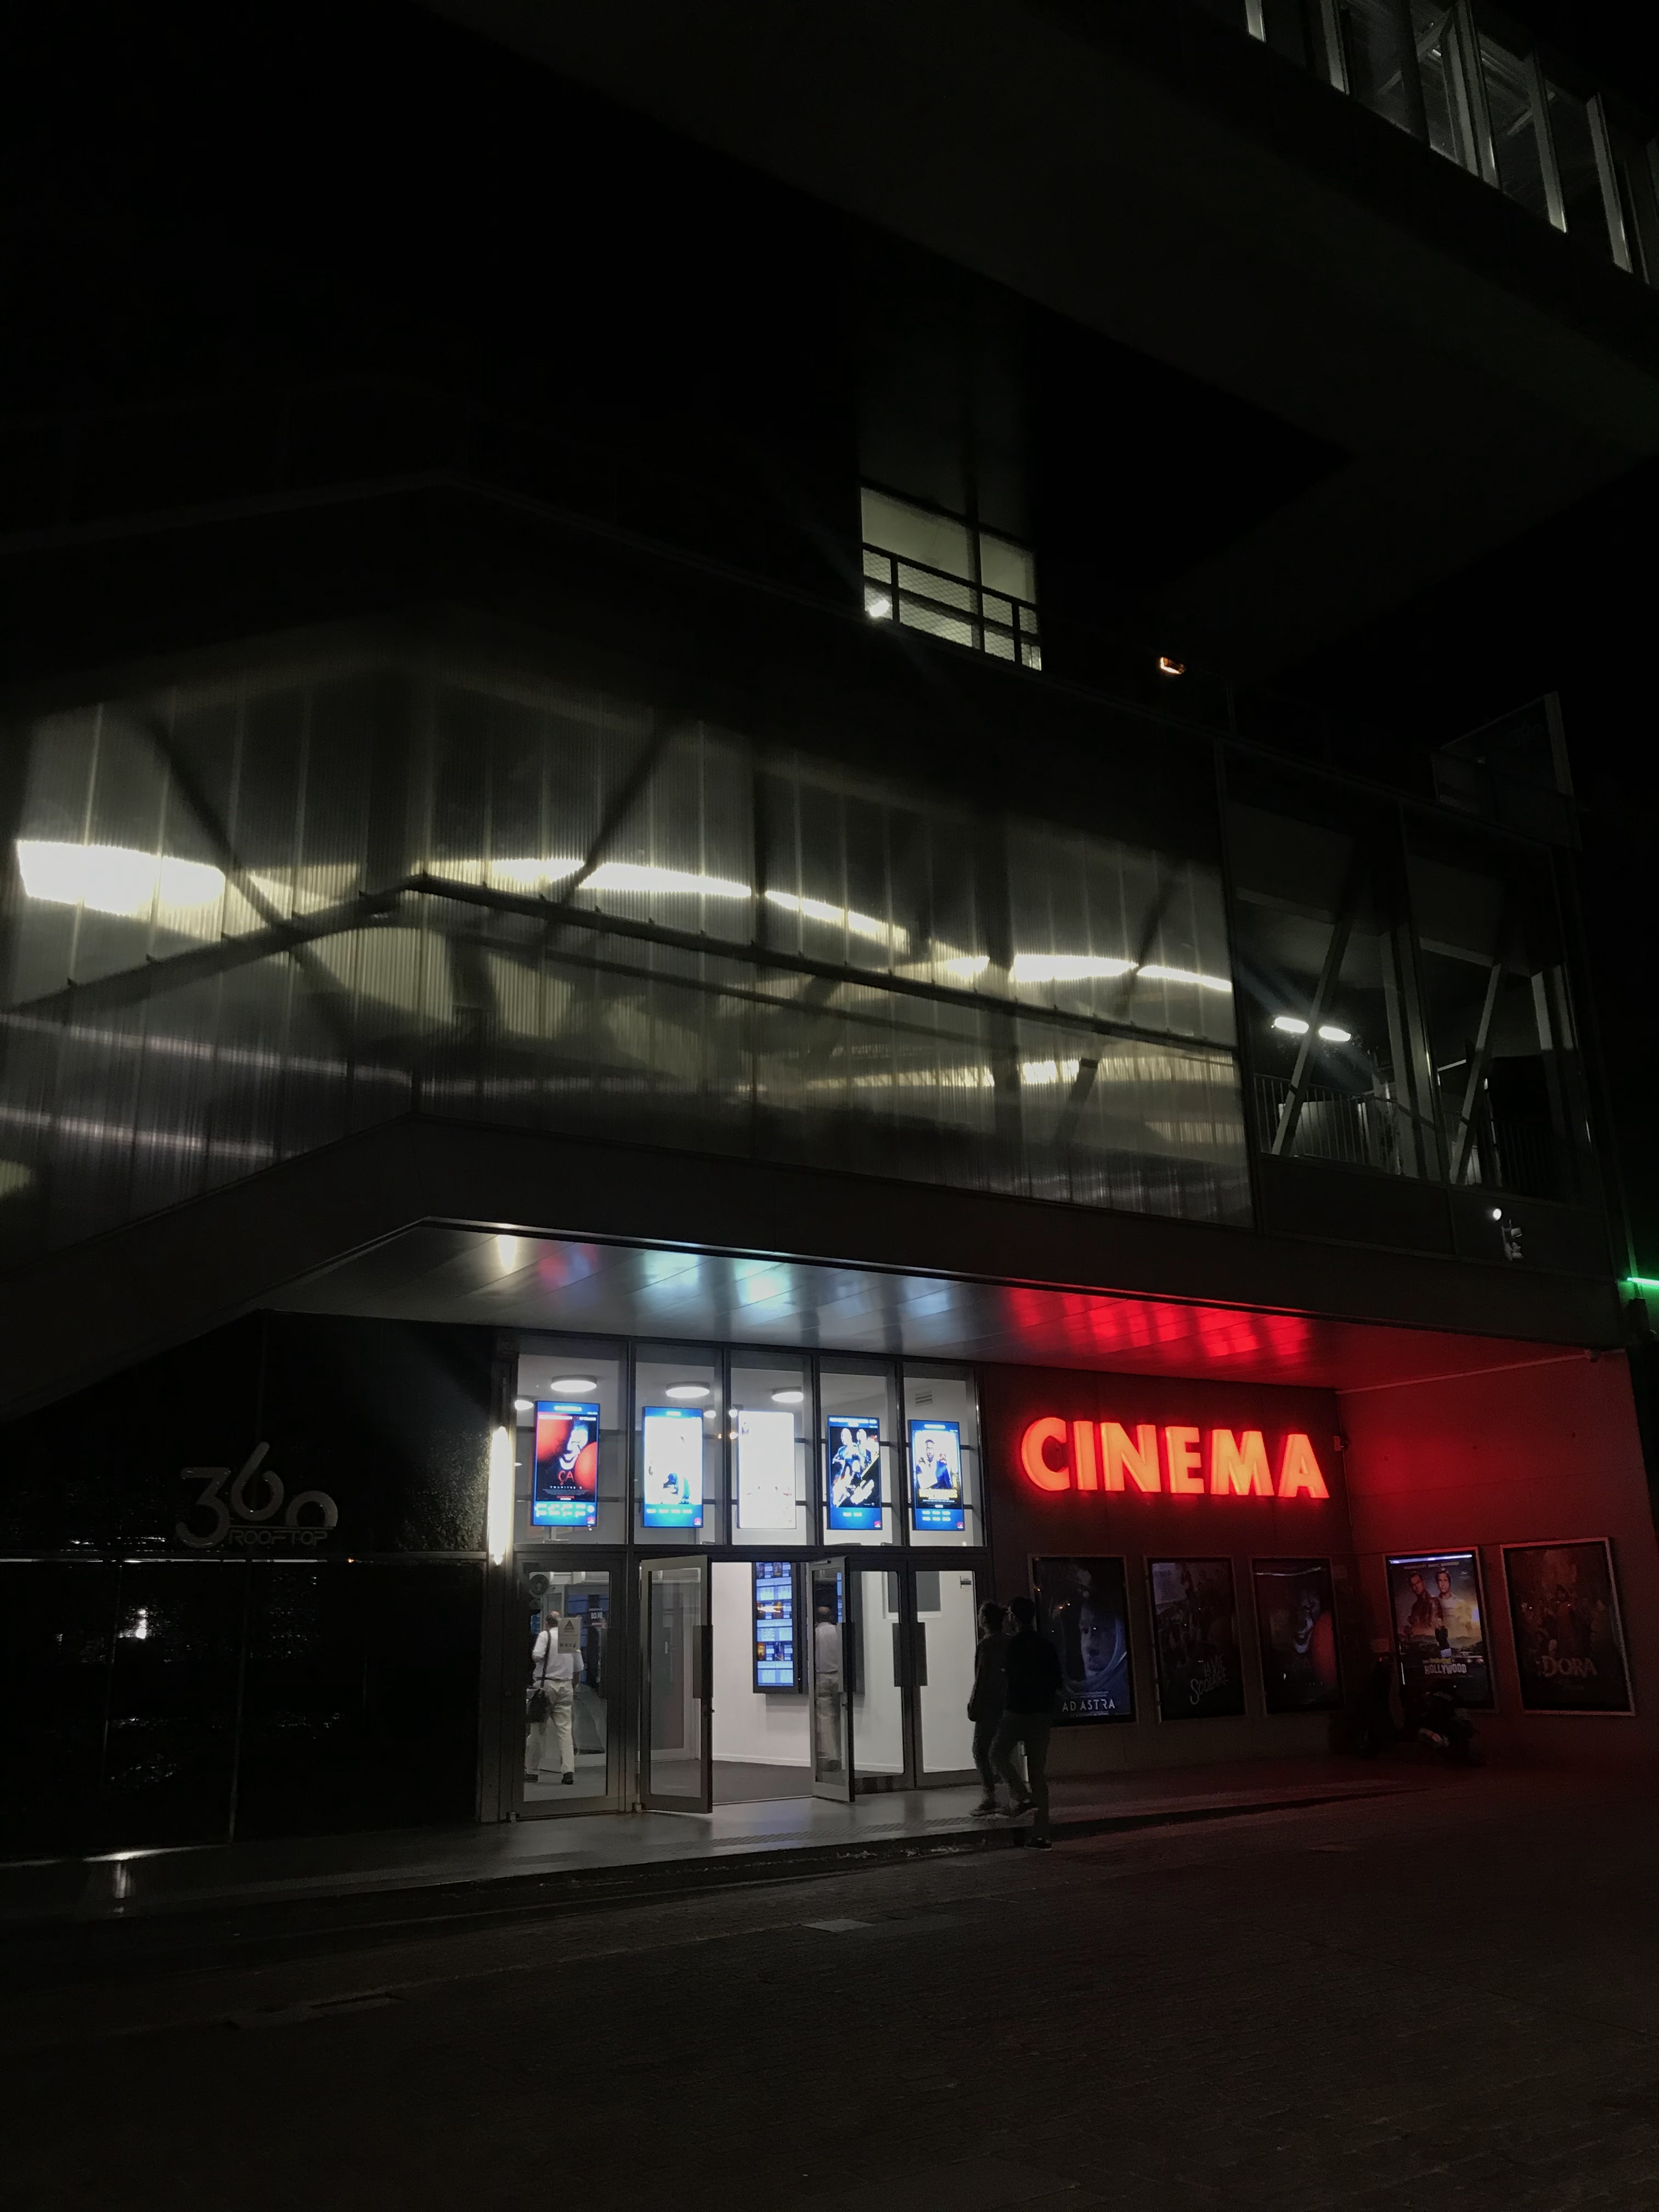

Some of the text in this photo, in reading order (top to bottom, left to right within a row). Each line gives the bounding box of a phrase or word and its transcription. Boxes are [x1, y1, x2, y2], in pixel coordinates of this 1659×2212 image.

[1021, 1417, 1330, 1498] CINEMA
[558, 1470, 574, 1485] ÇA
[175, 1441, 338, 1549] 360
[228, 1530, 328, 1545] ROOFTOP
[1540, 1655, 1598, 1678] DORA
[1062, 1698, 1116, 1712] AD ASTRA
